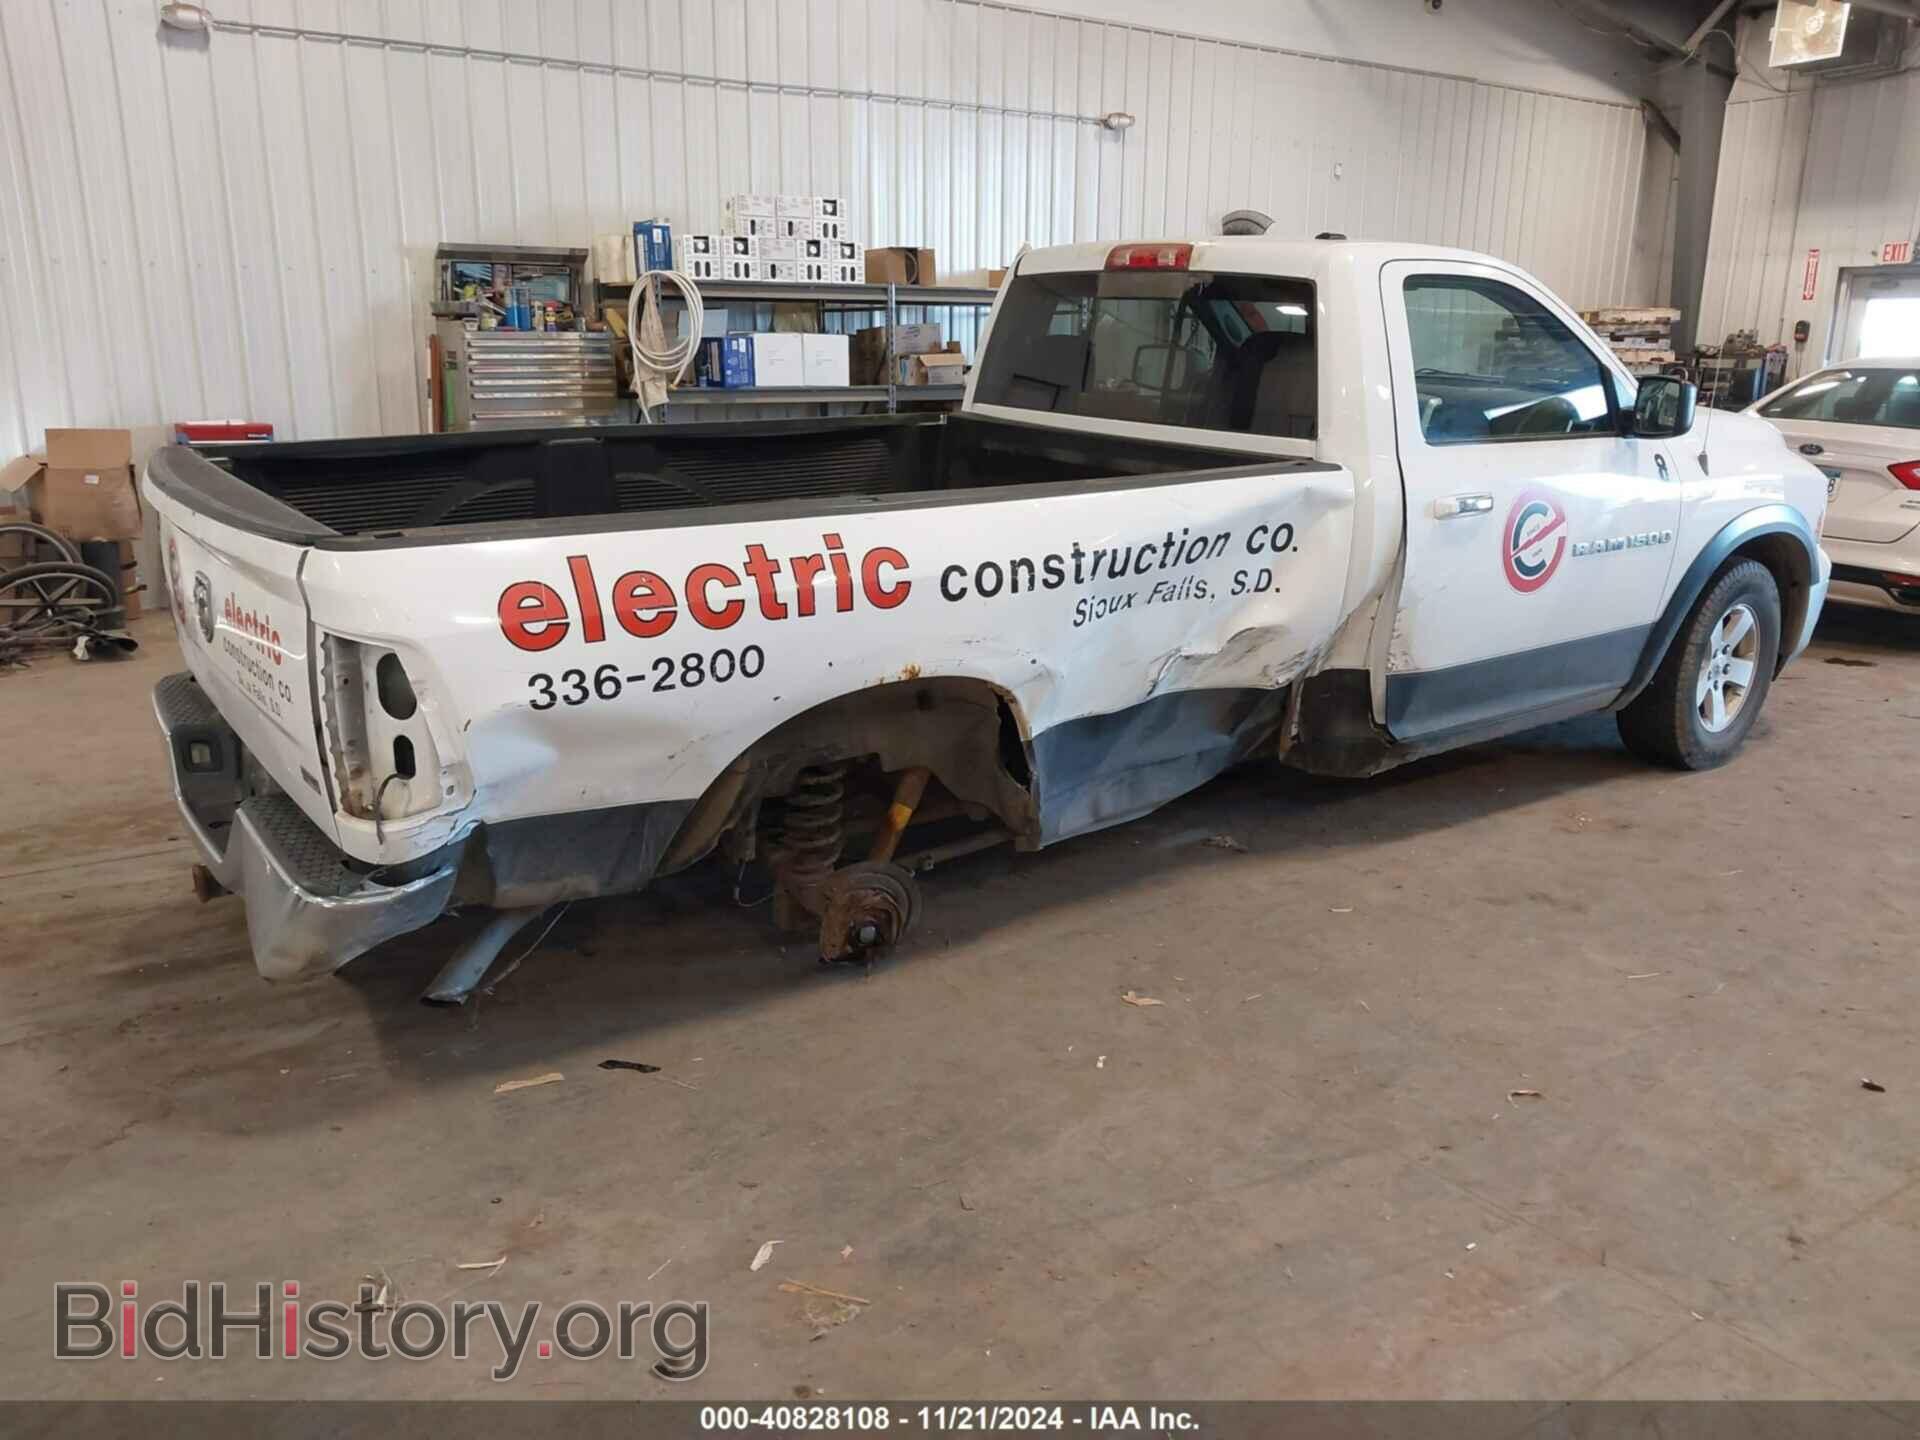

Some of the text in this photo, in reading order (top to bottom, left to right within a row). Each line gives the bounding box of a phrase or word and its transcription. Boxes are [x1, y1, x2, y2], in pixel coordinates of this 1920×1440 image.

[1882, 242, 1909, 262] EXIT
[940, 528, 1231, 602] construction
[1626, 530, 1672, 549] 1500
[498, 533, 912, 652] electric
[1073, 592, 1138, 627] Sioux
[1231, 568, 1281, 596] S.D.
[527, 644, 765, 711] 336-2800
